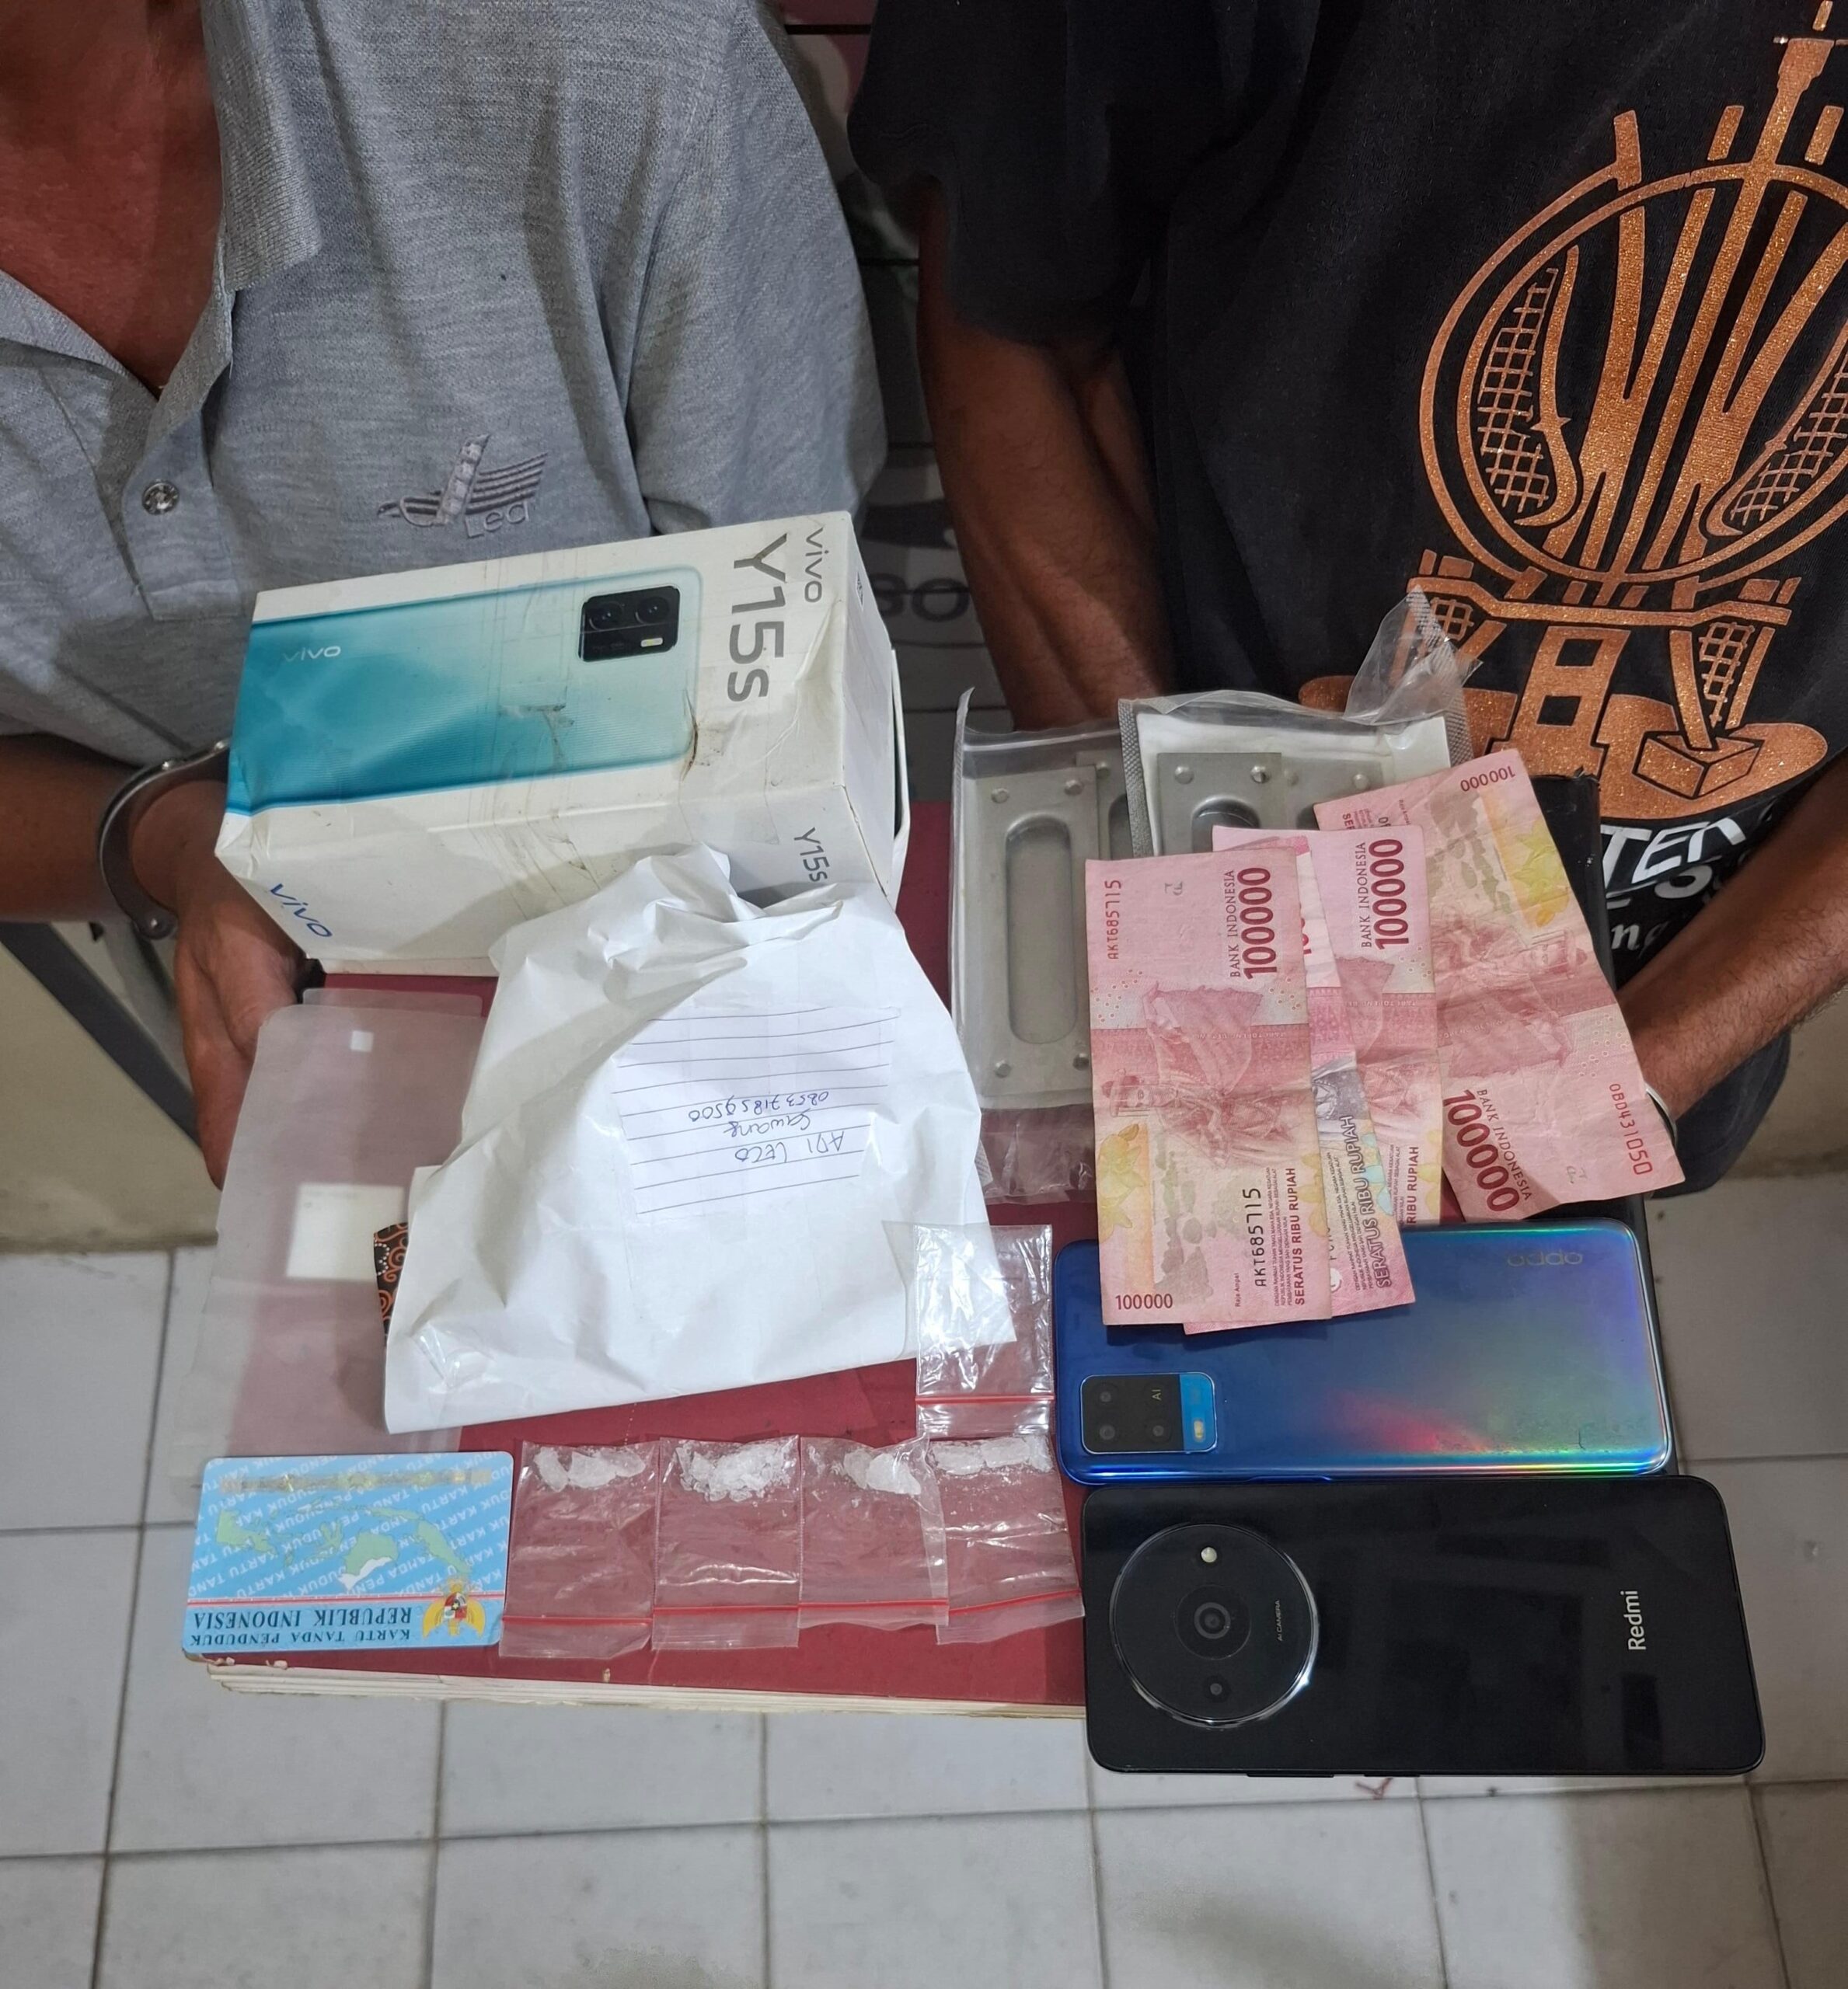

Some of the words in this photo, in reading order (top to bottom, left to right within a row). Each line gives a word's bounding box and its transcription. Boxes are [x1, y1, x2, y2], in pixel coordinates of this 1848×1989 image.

[804, 527, 829, 603] vivo
[727, 533, 788, 702] Y15s
[281, 646, 341, 662] vivo
[1460, 766, 1515, 792] 100000
[793, 827, 830, 882] Y15s
[1355, 842, 1369, 908] INDONESIA
[270, 883, 332, 937] vivo
[1224, 870, 1237, 937] INDONESIA
[1369, 839, 1409, 949] 100000
[1104, 880, 1121, 959] AKT685715
[1237, 868, 1277, 979] 100000
[1359, 915, 1372, 947] BANK
[1227, 944, 1240, 977] BANK
[807, 1130, 844, 1154] ADI
[1339, 1115, 1364, 1174] RUPIAH
[1443, 1089, 1519, 1211] 100000
[1477, 1089, 1499, 1121] BANK
[1491, 1127, 1532, 1200] INDONESIA
[1285, 1169, 1298, 1210] RUPIAH
[1407, 1147, 1418, 1190] RUPIAH
[1355, 1178, 1376, 1214] RIBU
[1407, 1196, 1417, 1224] RIBU
[1243, 1189, 1267, 1287] AKT685715
[1289, 1215, 1301, 1243] RIBU
[1362, 1218, 1392, 1287] SERATUS
[1292, 1248, 1305, 1305] SERATUS
[1115, 1294, 1173, 1309] 100000
[1152, 1389, 1161, 1401] AI
[190, 1632, 280, 1646] PENDUDUK
[194, 1610, 301, 1630] INDONESIA
[291, 1632, 344, 1643] TANDA
[314, 1608, 412, 1627] REPUBLIK
[355, 1629, 410, 1642] KARTU
[1620, 1590, 1646, 1649] Redmi
